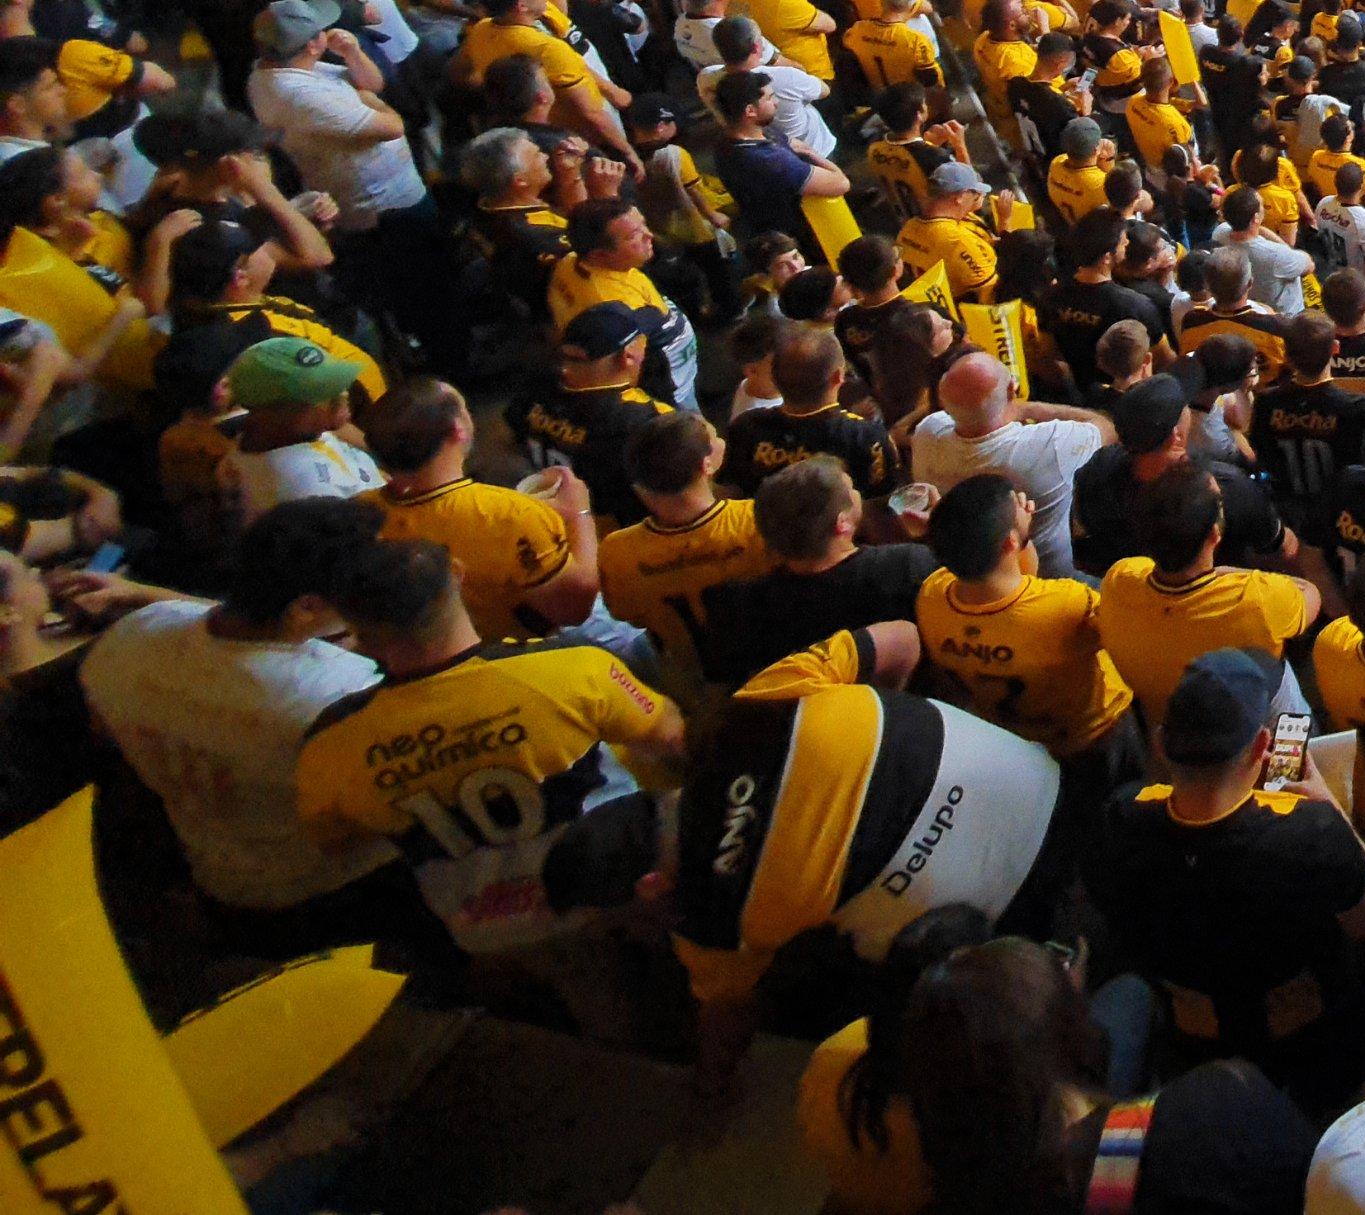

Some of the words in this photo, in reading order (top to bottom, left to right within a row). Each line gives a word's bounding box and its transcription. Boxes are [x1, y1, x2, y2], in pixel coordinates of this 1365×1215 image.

[938, 636, 1015, 664] ANJO
[400, 765, 549, 862] 10
[880, 784, 965, 899] Delupo
